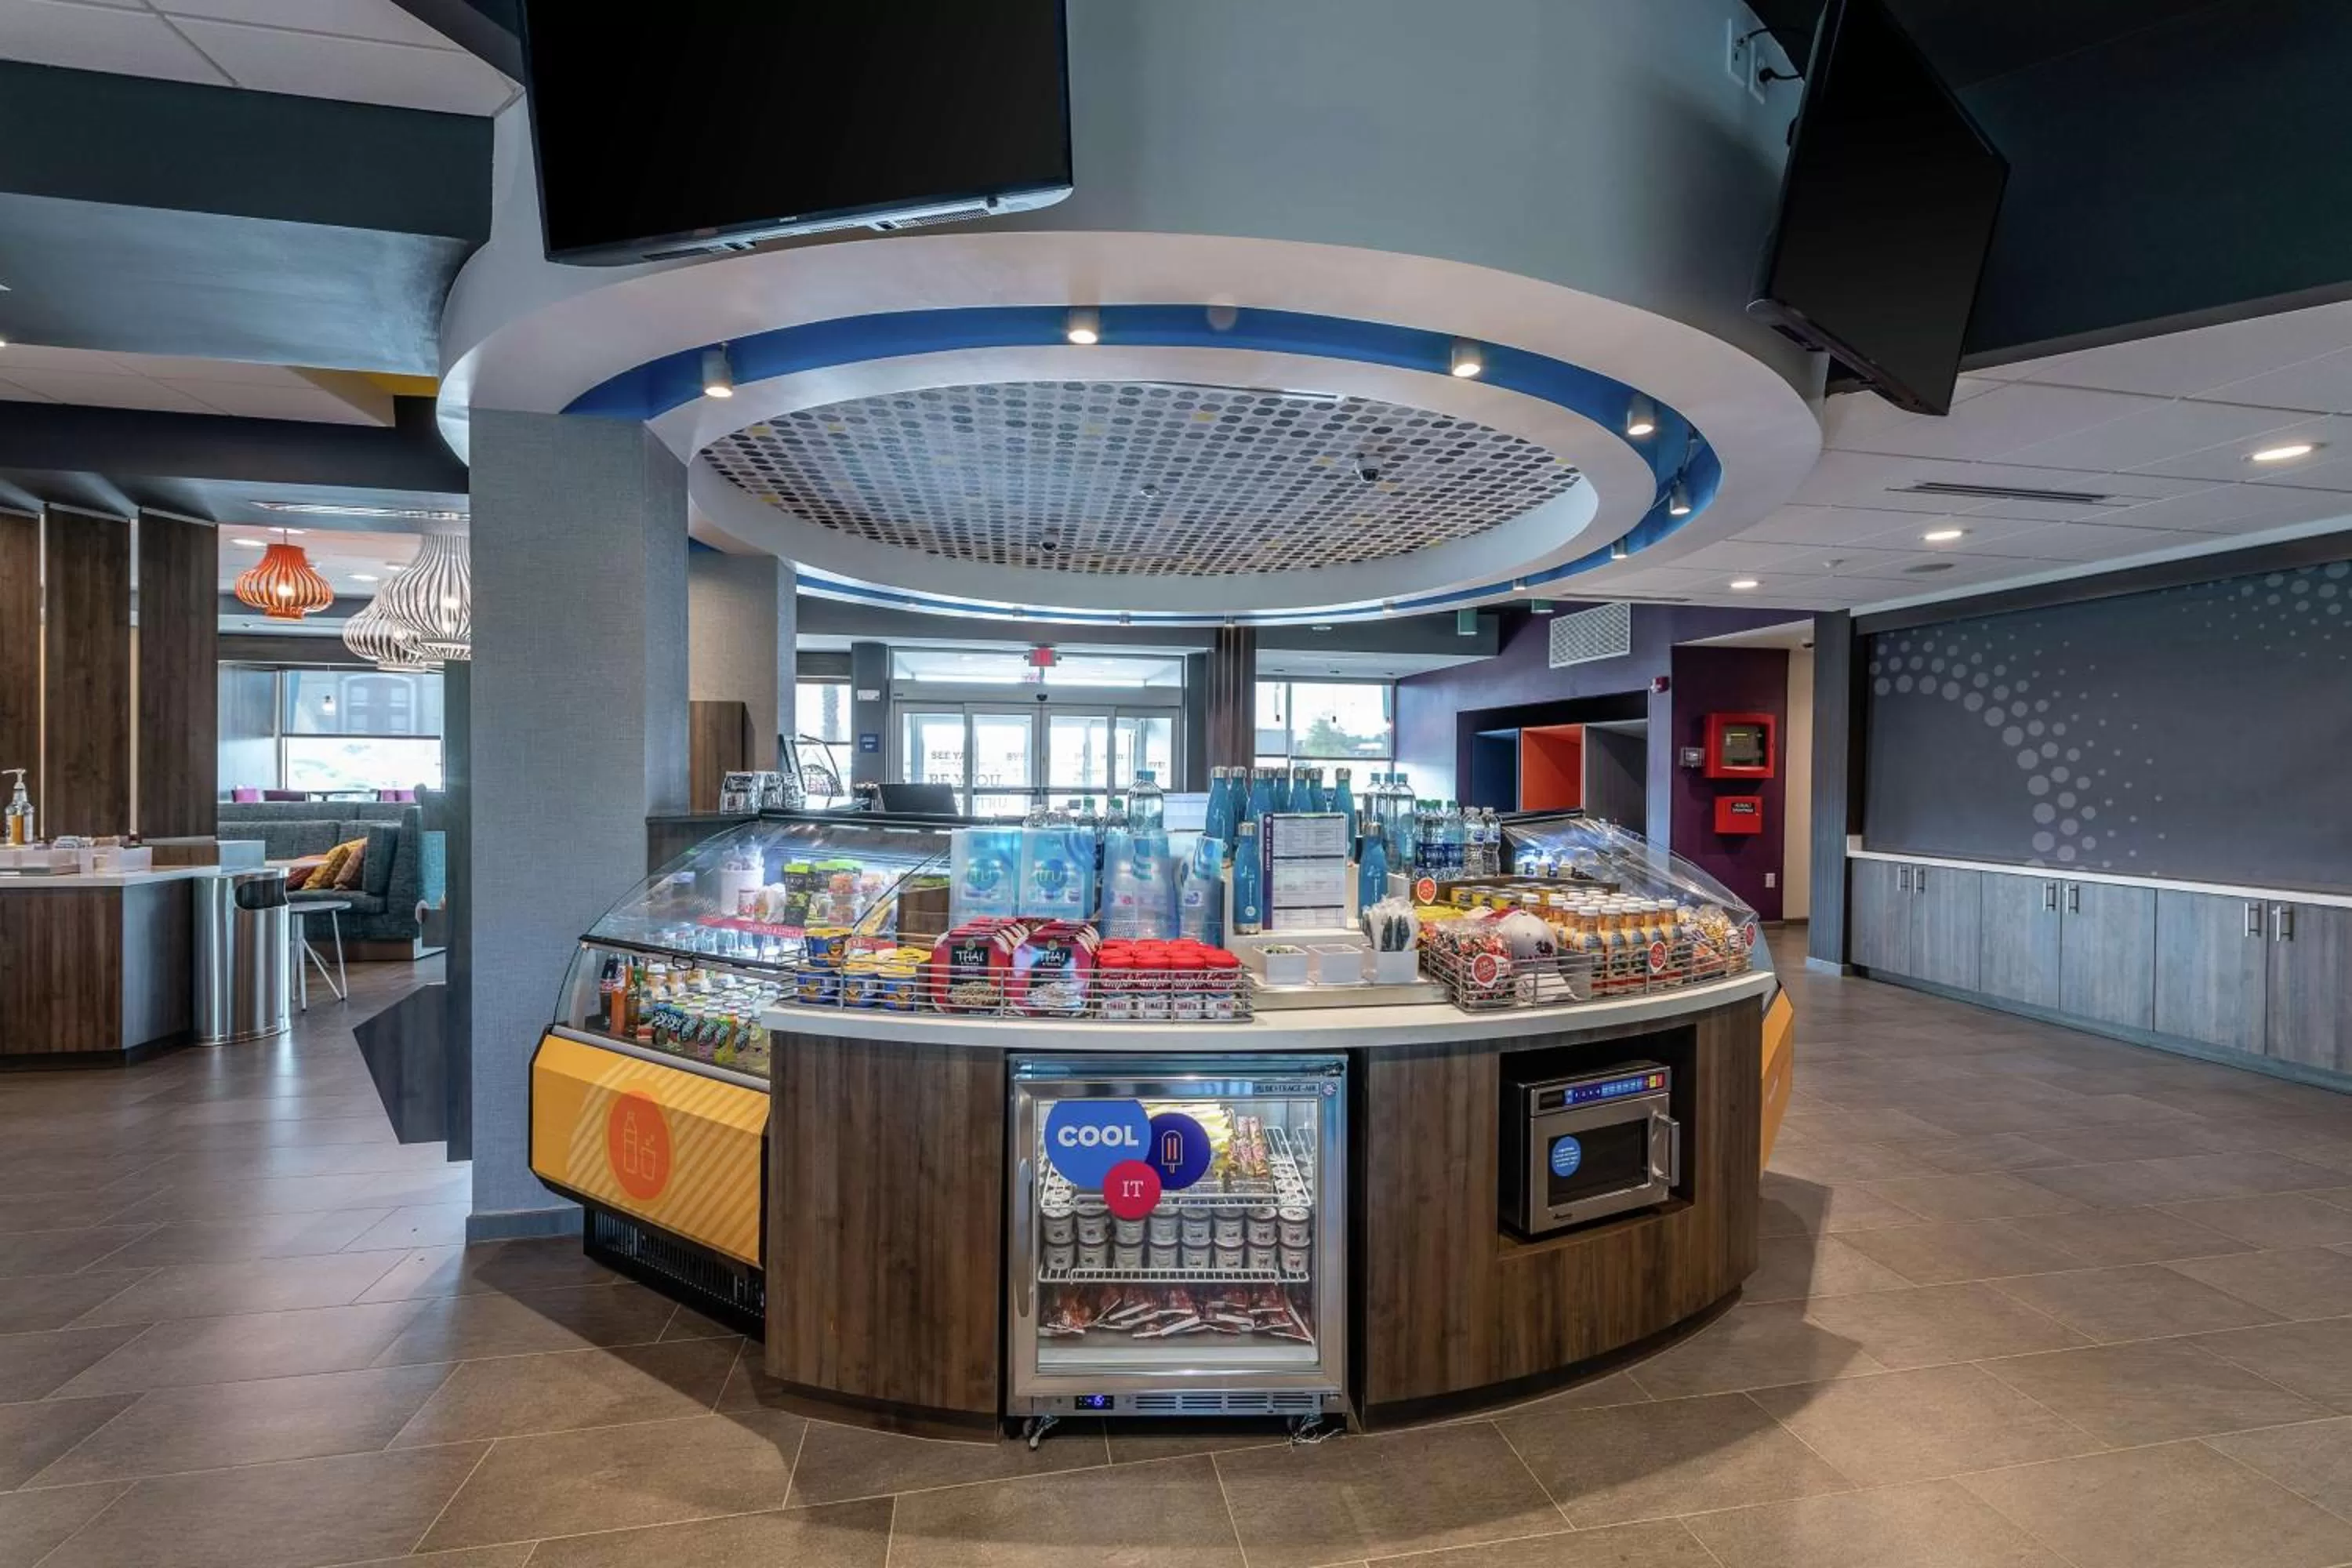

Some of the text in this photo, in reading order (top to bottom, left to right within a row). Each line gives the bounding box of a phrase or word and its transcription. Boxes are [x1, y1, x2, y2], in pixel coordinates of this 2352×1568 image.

[956, 949, 984, 963] THAI
[1058, 1125, 1139, 1147] COOL
[1123, 1179, 1144, 1197] IT
